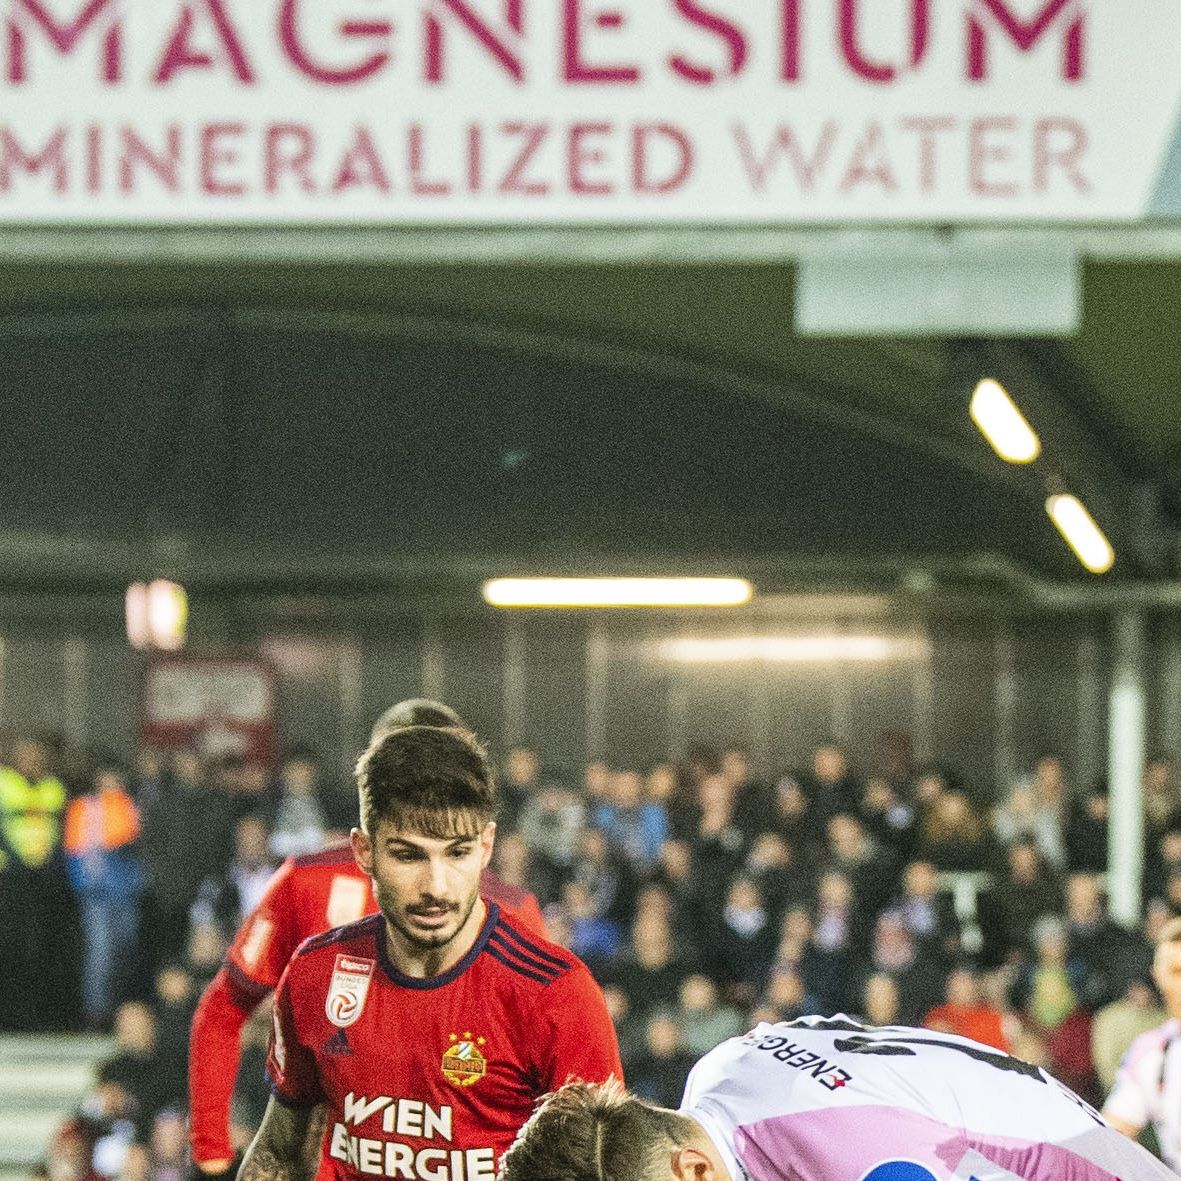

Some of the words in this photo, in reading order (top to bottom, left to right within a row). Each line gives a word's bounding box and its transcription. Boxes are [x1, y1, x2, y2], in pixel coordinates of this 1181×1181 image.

[0, 121, 696, 196] MINERALIZED
[732, 116, 1094, 196] WATER
[755, 1034, 853, 1091] ENERG
[344, 1091, 453, 1141] WIEN
